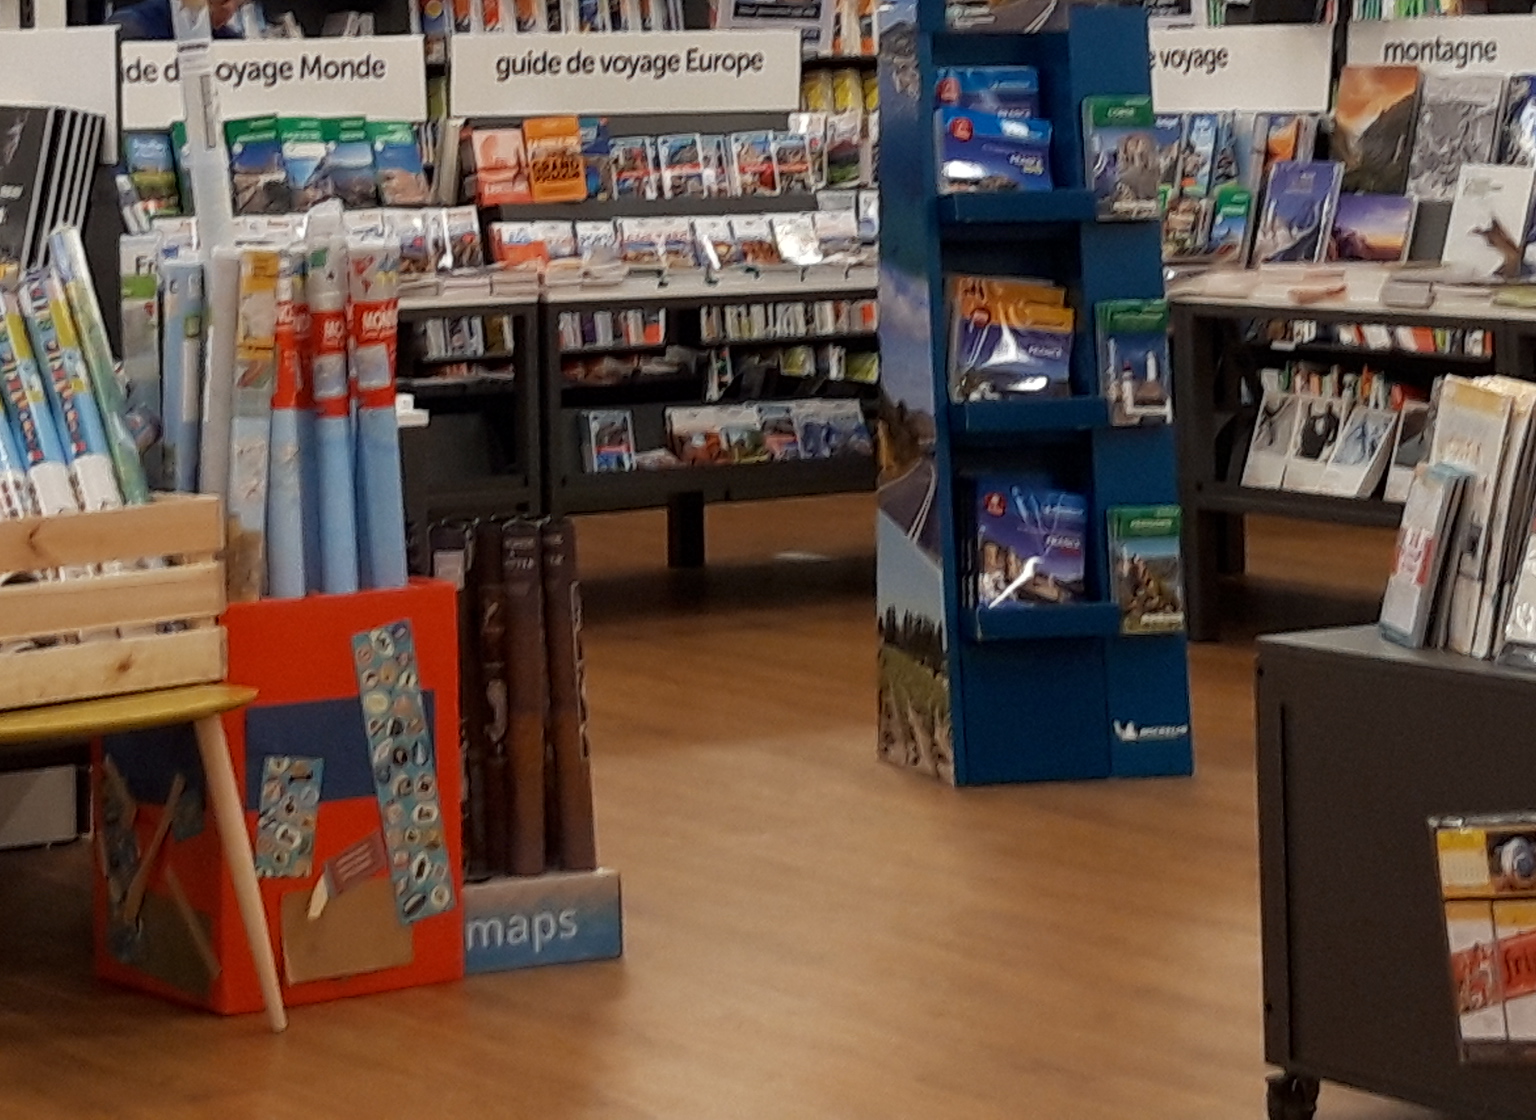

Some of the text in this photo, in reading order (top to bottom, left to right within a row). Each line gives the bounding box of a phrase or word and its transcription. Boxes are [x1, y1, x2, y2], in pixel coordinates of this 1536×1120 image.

[496, 47, 764, 80] guide de voyage Europe
[1159, 46, 1229, 73] voyage
[1383, 35, 1498, 68] montagne
[215, 60, 294, 87] oyage
[300, 53, 387, 82] Monde
[466, 906, 578, 954] maps
